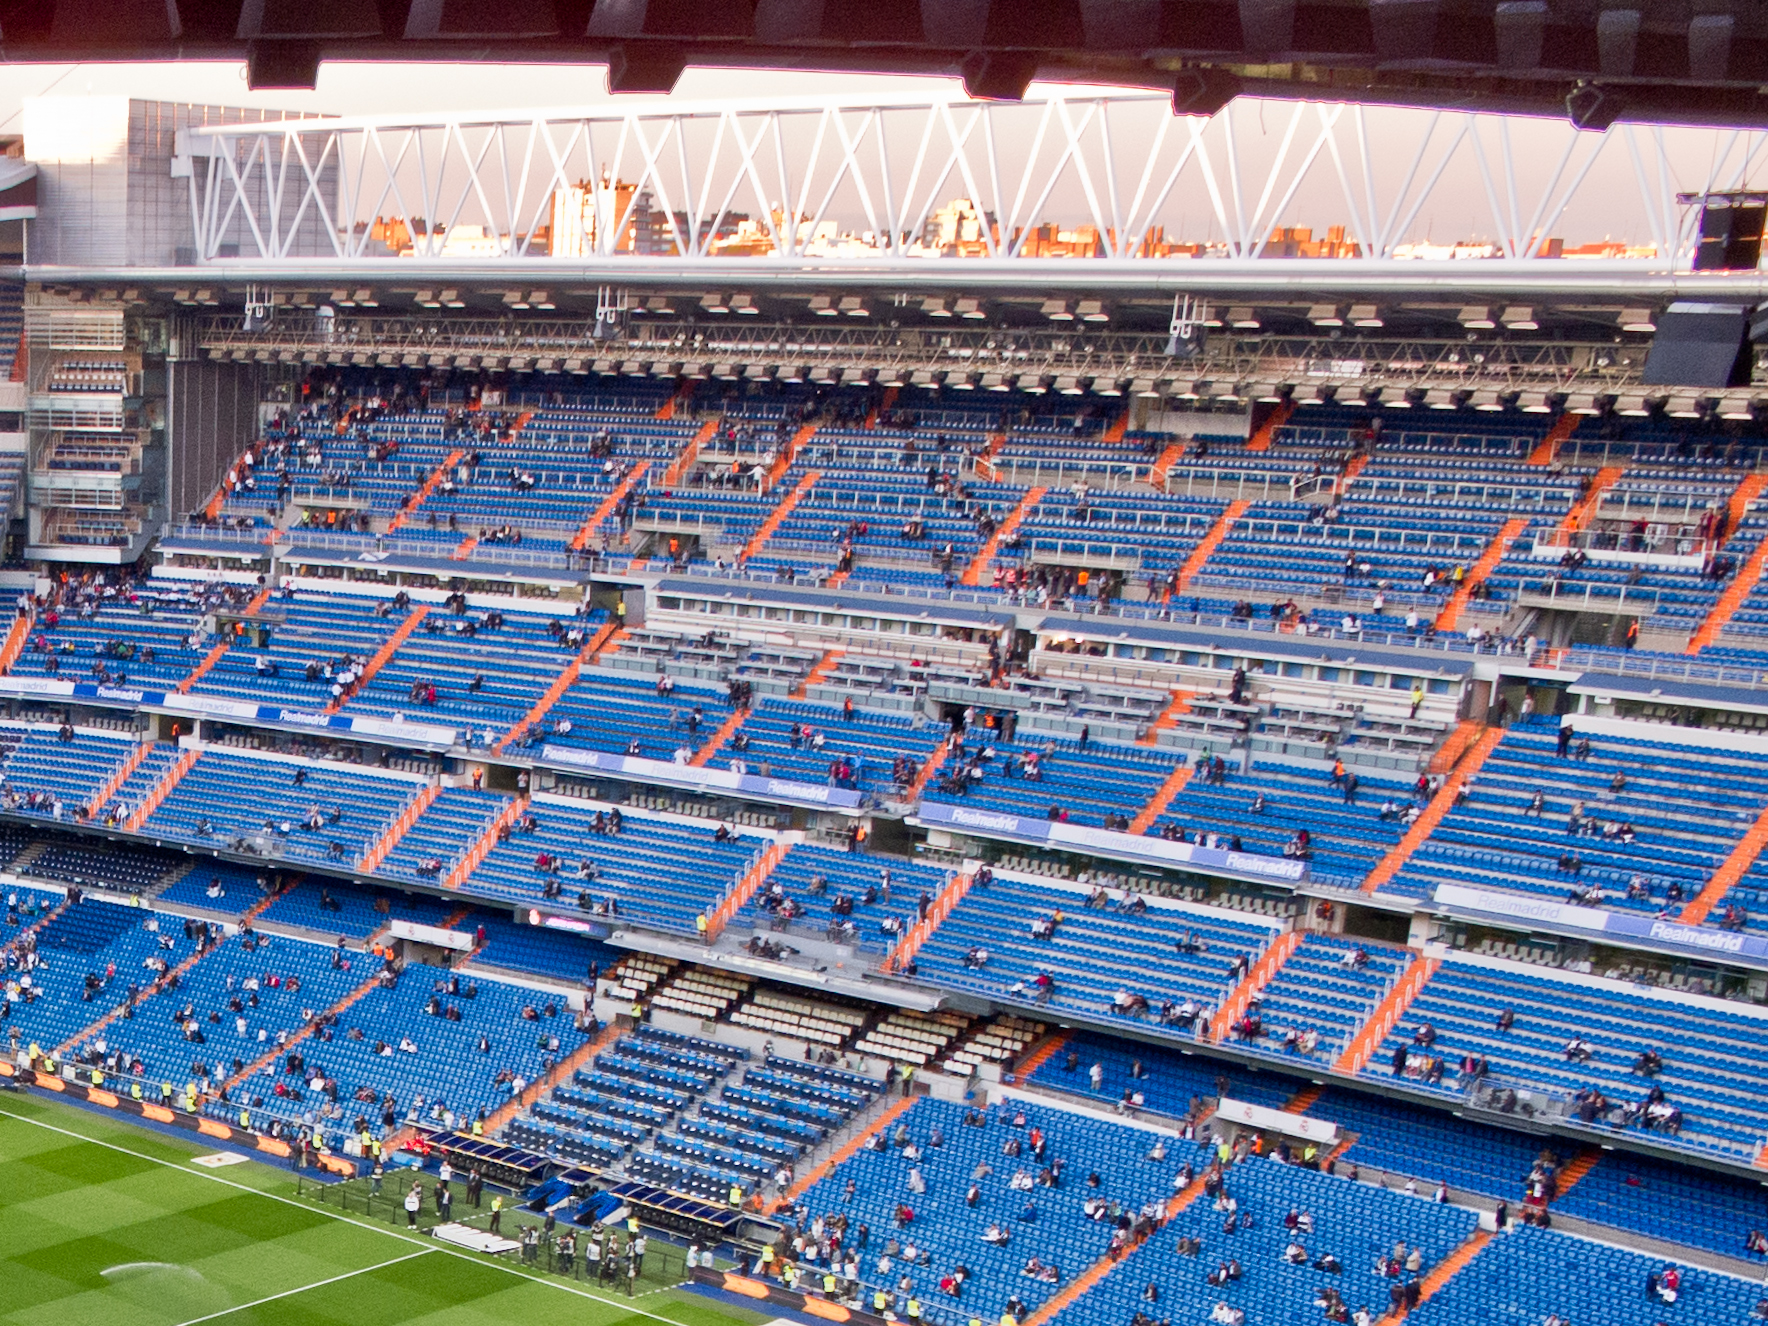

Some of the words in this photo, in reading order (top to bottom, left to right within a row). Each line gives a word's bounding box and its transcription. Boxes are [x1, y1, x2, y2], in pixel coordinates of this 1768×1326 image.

[951, 809, 1019, 831] Realmadrid
[1225, 853, 1303, 878] Realmadrid
[1477, 894, 1560, 919] Realmadrid
[1649, 922, 1743, 952] Realmadrid
